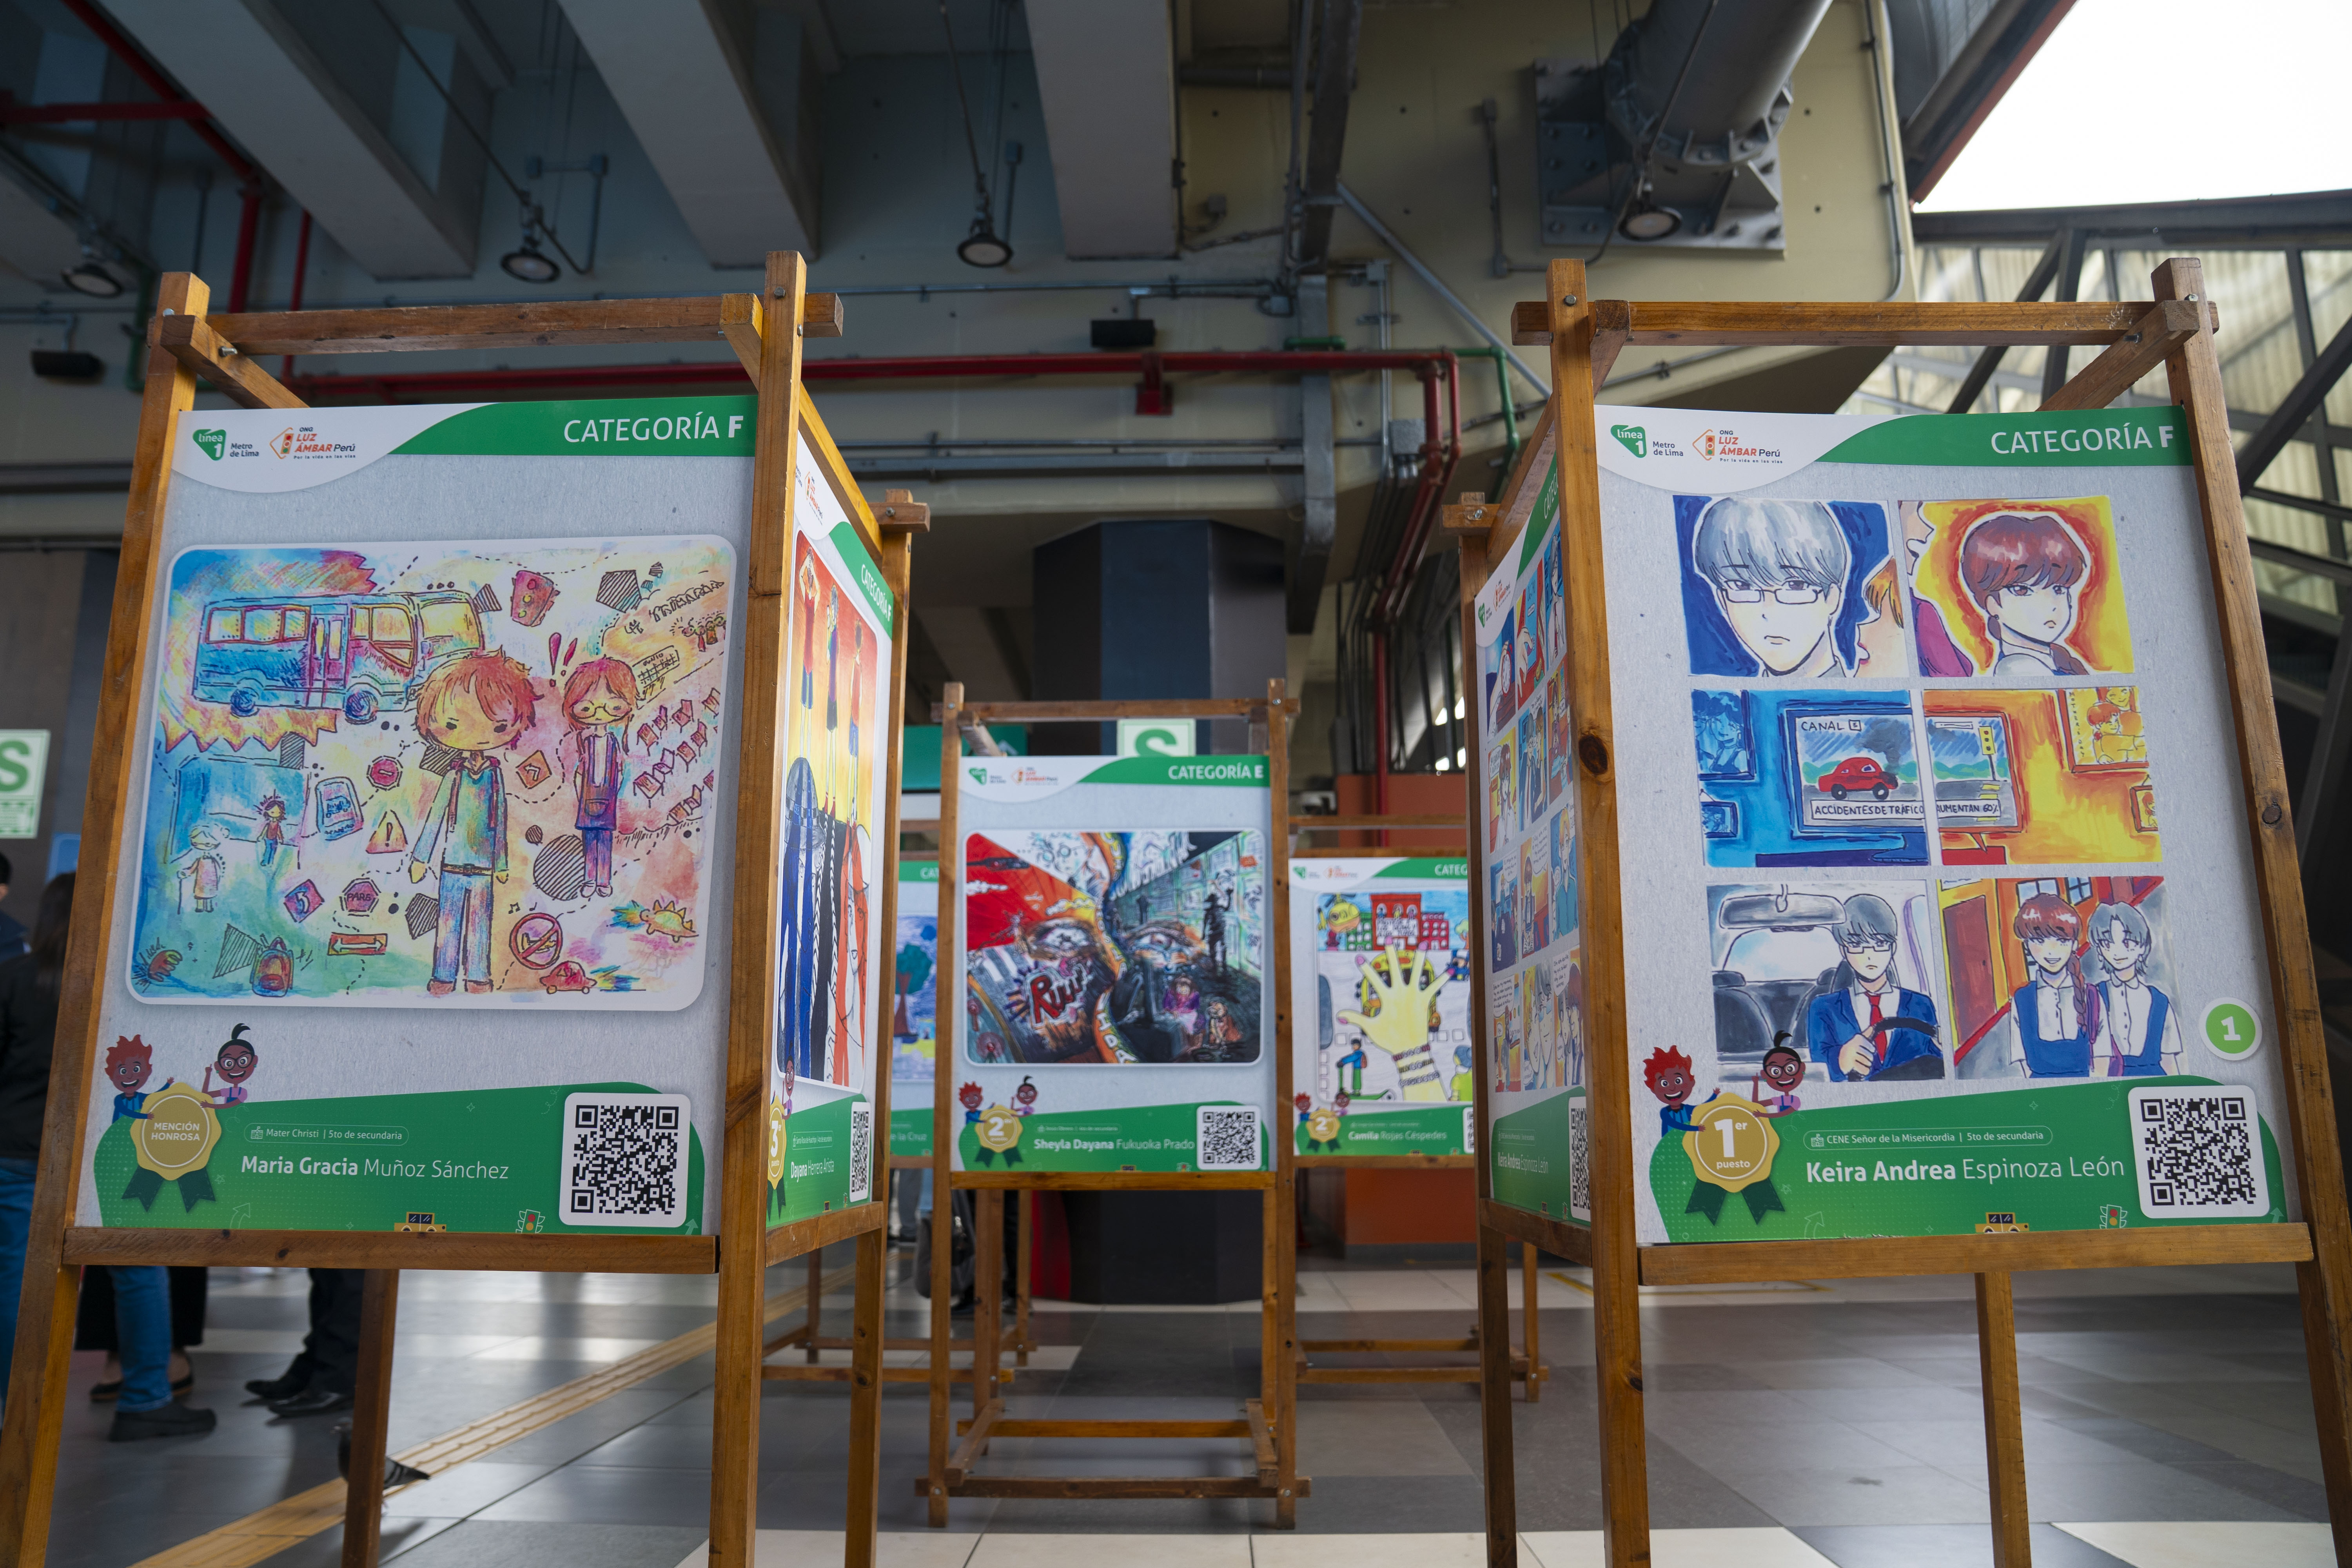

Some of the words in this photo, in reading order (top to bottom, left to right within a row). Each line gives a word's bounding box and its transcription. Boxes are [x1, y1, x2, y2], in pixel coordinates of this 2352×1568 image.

[564, 411, 720, 443] CATEGORÍA
[728, 415, 744, 438] F
[296, 433, 317, 442] LUZ
[1719, 436, 1739, 445] LUZ
[1991, 422, 2153, 454] CATEGORÍA
[2158, 425, 2174, 448] F
[214, 443, 223, 458] 1
[294, 442, 333, 453] ÁMBAR
[333, 443, 356, 452] Perú
[1635, 440, 1644, 455] 1
[1664, 449, 1684, 457] Lima
[1719, 445, 1757, 456] ÁMBAR
[1759, 448, 1781, 458] Perú
[861, 563, 888, 617] CATEGORÍA
[887, 606, 892, 622] F
[1801, 720, 1845, 731] CANAL
[1168, 762, 1252, 780] CATEGORÍA
[1254, 765, 1264, 779] E
[1982, 802, 1999, 815] 60%
[2220, 1016, 2241, 1041] 1
[154, 1121, 200, 1132] MENCIÓN
[151, 1131, 201, 1142] HONROSA
[266, 1128, 289, 1138] Mater
[292, 1128, 319, 1138] Christi
[328, 1129, 341, 1139] 5to
[344, 1129, 354, 1139] de
[357, 1130, 402, 1140] secundaria
[1348, 1131, 1380, 1141] Camila
[1827, 1135, 1850, 1144] CENE
[1851, 1133, 1877, 1143] Señor
[1880, 1134, 1890, 1143] de
[1891, 1134, 1900, 1143] la
[1902, 1132, 1955, 1143] Misericordia
[1967, 1132, 1982, 1142] 5to
[1984, 1132, 1994, 1141] de
[1996, 1131, 2043, 1141] secundaria
[1034, 1139, 1071, 1152] Sheyla
[1073, 1139, 1114, 1152] Dayana
[1116, 1139, 1161, 1149] Fukuoka
[1163, 1139, 1195, 1150] Prado
[241, 1156, 294, 1175] Maria
[299, 1157, 358, 1176] Gracia
[364, 1158, 426, 1178] Muñoz
[431, 1159, 509, 1180] Sánchez
[791, 1160, 808, 1183] Dayana
[808, 1159, 823, 1176] Herrera
[823, 1157, 835, 1174] Arista
[1716, 1159, 1751, 1170] puesto
[1806, 1161, 1867, 1183] Keira
[1873, 1160, 1956, 1181] Andrea
[1963, 1158, 2062, 1185] Espinoza
[2069, 1156, 2125, 1178] León
